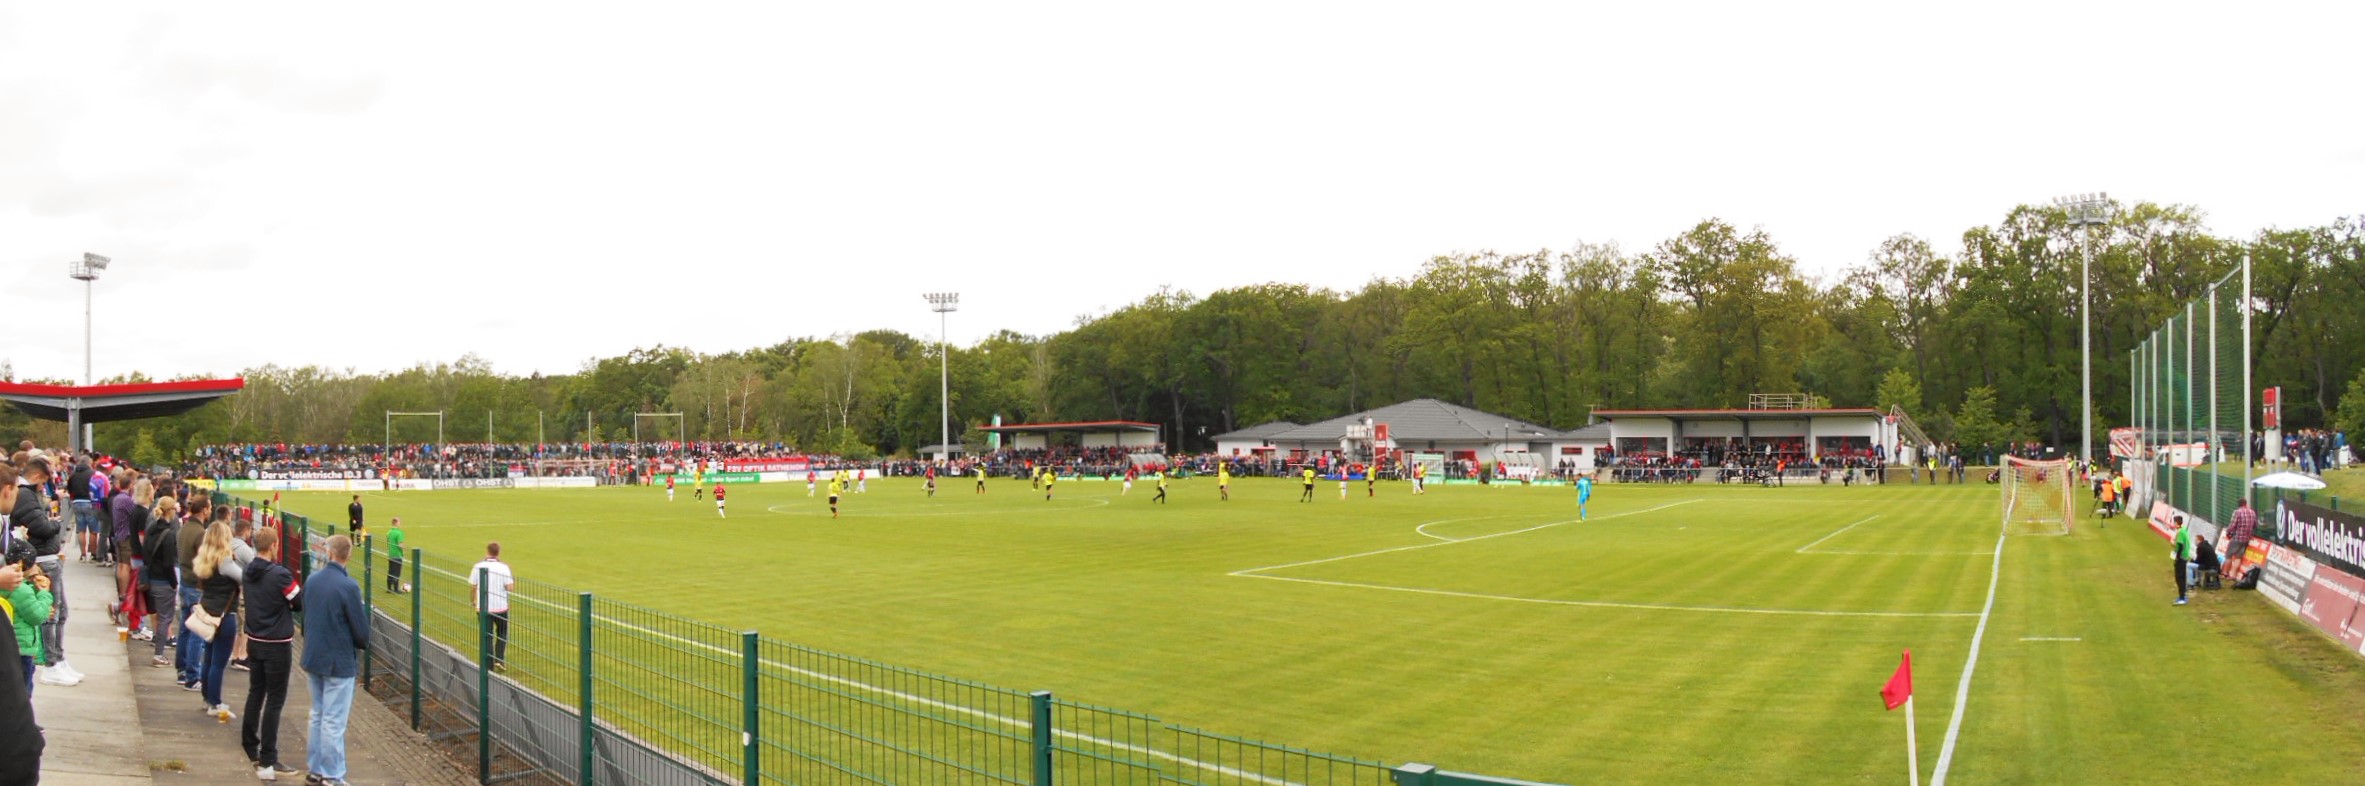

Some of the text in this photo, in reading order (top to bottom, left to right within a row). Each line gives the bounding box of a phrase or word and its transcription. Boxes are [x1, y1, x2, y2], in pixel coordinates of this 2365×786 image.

[727, 464, 806, 473] FSV OPTIK RATHENOW
[261, 470, 278, 479] Der
[433, 478, 460, 487] OHST
[475, 478, 502, 487] OHST
[2288, 510, 2304, 545] Der
